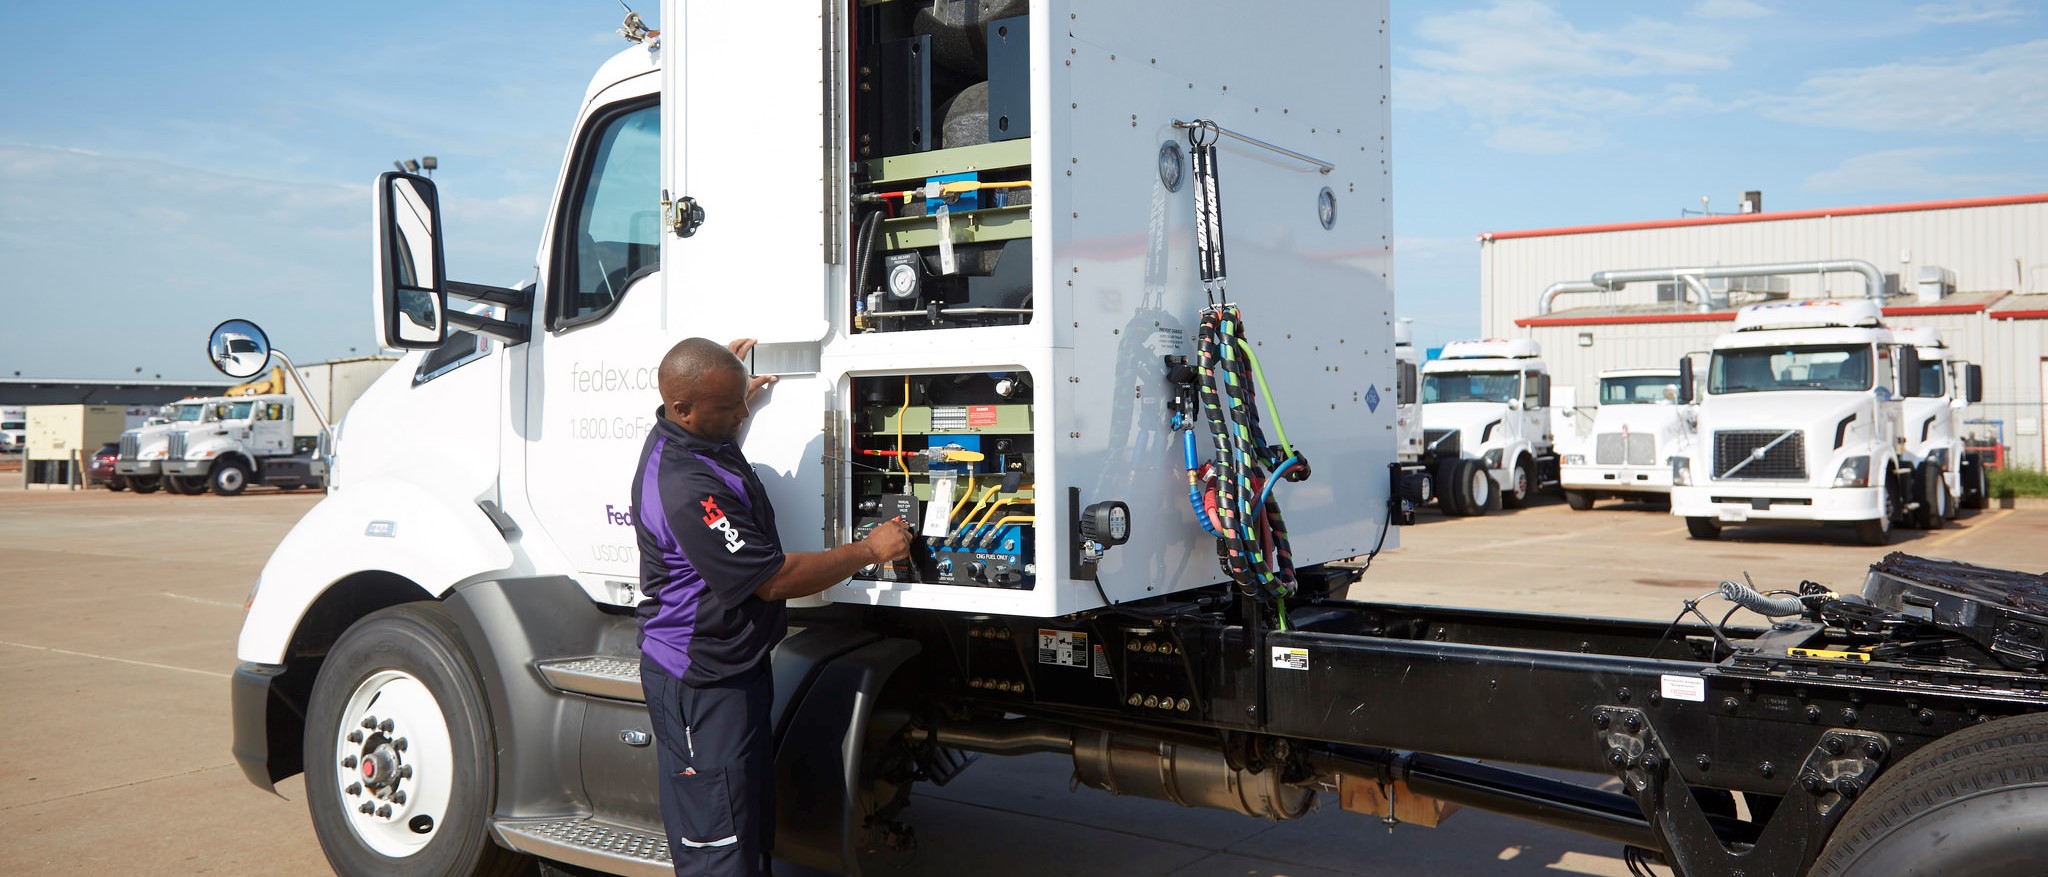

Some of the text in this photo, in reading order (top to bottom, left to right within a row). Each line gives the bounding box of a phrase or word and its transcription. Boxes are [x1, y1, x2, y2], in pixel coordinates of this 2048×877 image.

[571, 360, 659, 392] fedex.co
[570, 417, 653, 439] 1.800.GoFe
[606, 504, 635, 526] Fed
[700, 495, 746, 554] FedEx
[591, 544, 634, 563] USDOT
